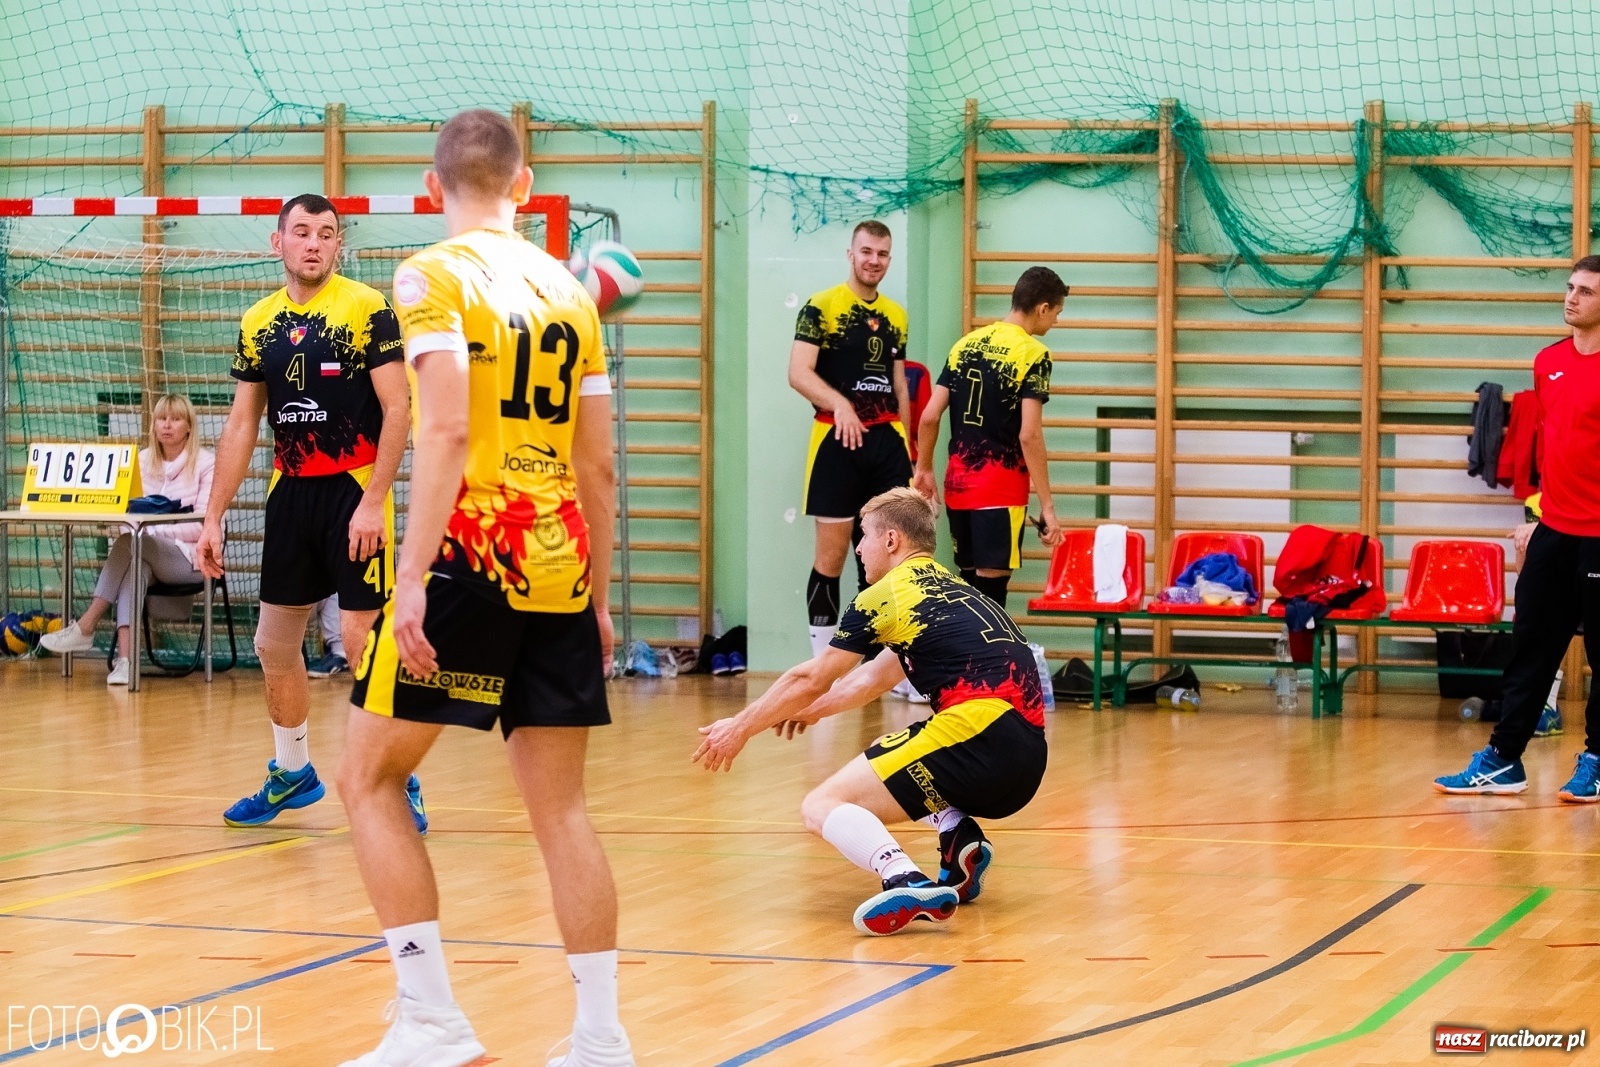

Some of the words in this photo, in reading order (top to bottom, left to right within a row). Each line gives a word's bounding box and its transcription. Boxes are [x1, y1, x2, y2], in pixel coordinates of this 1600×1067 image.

[867, 336, 884, 363] 9
[285, 353, 305, 391] 4
[501, 312, 580, 425] 13
[851, 381, 892, 393] Joanna
[963, 367, 984, 427] 1
[276, 410, 328, 424] Joanna
[500, 453, 568, 476] Joanna
[363, 557, 381, 594] 4
